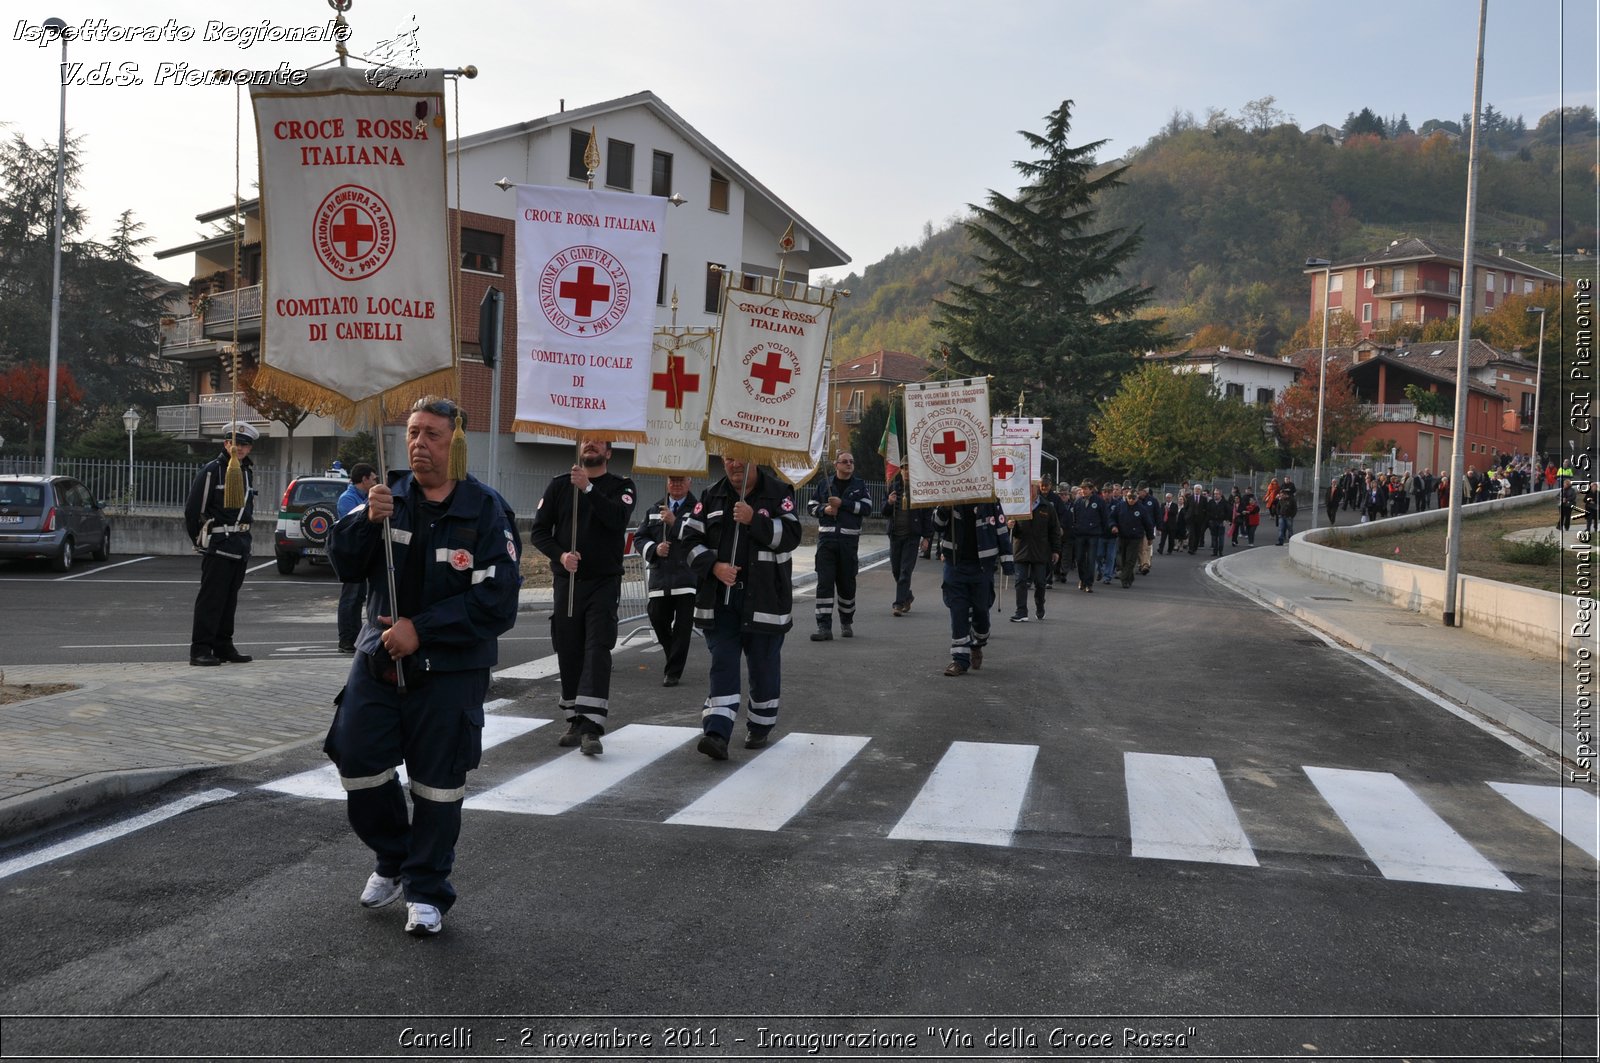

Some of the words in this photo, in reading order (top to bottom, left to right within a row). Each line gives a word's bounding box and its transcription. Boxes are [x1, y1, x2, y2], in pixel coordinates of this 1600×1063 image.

[274, 118, 345, 140] CROCE
[300, 146, 405, 166] ITALIANA
[326, 201, 336, 213] DI
[334, 191, 371, 206] GINEVRA
[369, 202, 382, 215] 22
[524, 208, 562, 224] CROCE
[566, 213, 600, 228] ROSSA
[604, 216, 656, 232] ITALIANA
[319, 212, 345, 273] CONVENZIONE
[377, 216, 390, 255] AGOSTO
[359, 254, 381, 272] 1864
[556, 254, 569, 267] DI
[570, 248, 613, 269] GINEVRA
[611, 266, 624, 279] 22
[541, 264, 570, 329] CONVENZIONE
[609, 281, 629, 320] AGOSTO
[276, 297, 359, 317] COMITATO
[367, 297, 435, 319] LOCALE
[739, 303, 779, 318] CROCE
[309, 323, 328, 342] DI
[335, 322, 403, 342] CANELLI
[592, 317, 612, 334] 1864
[750, 319, 805, 337] ITALIANA
[531, 349, 586, 366] COMITATO
[590, 354, 633, 369] LOCALE
[742, 343, 764, 366] CORPO
[767, 341, 800, 376] VOLONTARI
[572, 375, 585, 387] DI
[550, 393, 607, 410] VOLTERRA
[742, 379, 754, 397] DEL
[754, 387, 796, 405] SOCCORSO
[720, 418, 800, 440] CASTELL'ALFERO
[737, 411, 776, 425] GRUPPO
[778, 417, 790, 428] DI
[909, 417, 928, 445] CROCE
[926, 406, 958, 420] ROSSA
[960, 409, 989, 439] ITALIANA
[938, 419, 966, 429] GINEVRA
[929, 425, 937, 434] DI
[922, 434, 946, 474] CONVENZIONE
[912, 487, 939, 496] BORGO
[942, 487, 949, 495] S.
[951, 483, 992, 494] DALMAZZO
[952, 476, 979, 486] LOCALE
